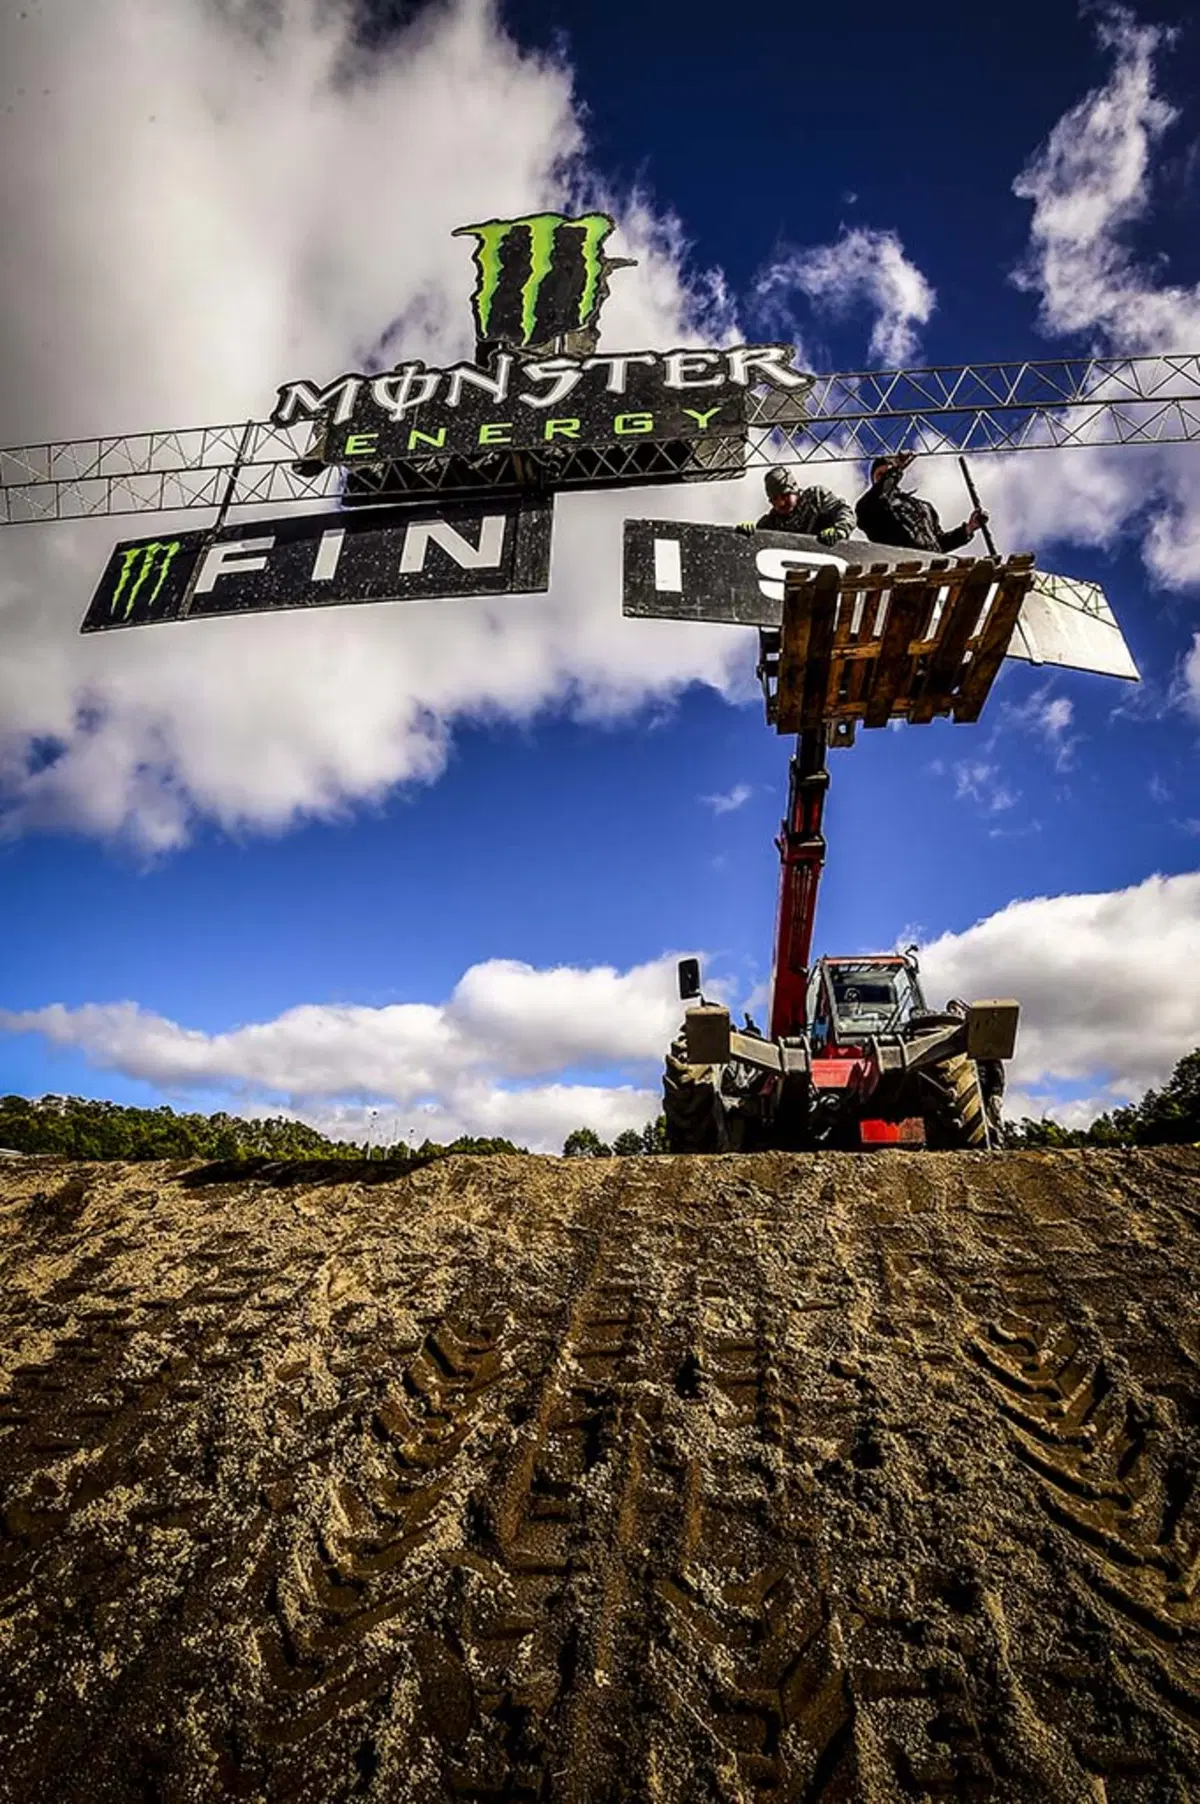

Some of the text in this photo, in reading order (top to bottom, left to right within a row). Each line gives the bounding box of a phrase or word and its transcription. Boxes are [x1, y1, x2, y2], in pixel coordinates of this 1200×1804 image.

[278, 348, 813, 425] MONSTER
[344, 407, 721, 456] ENERGY
[194, 515, 506, 594] FIN
